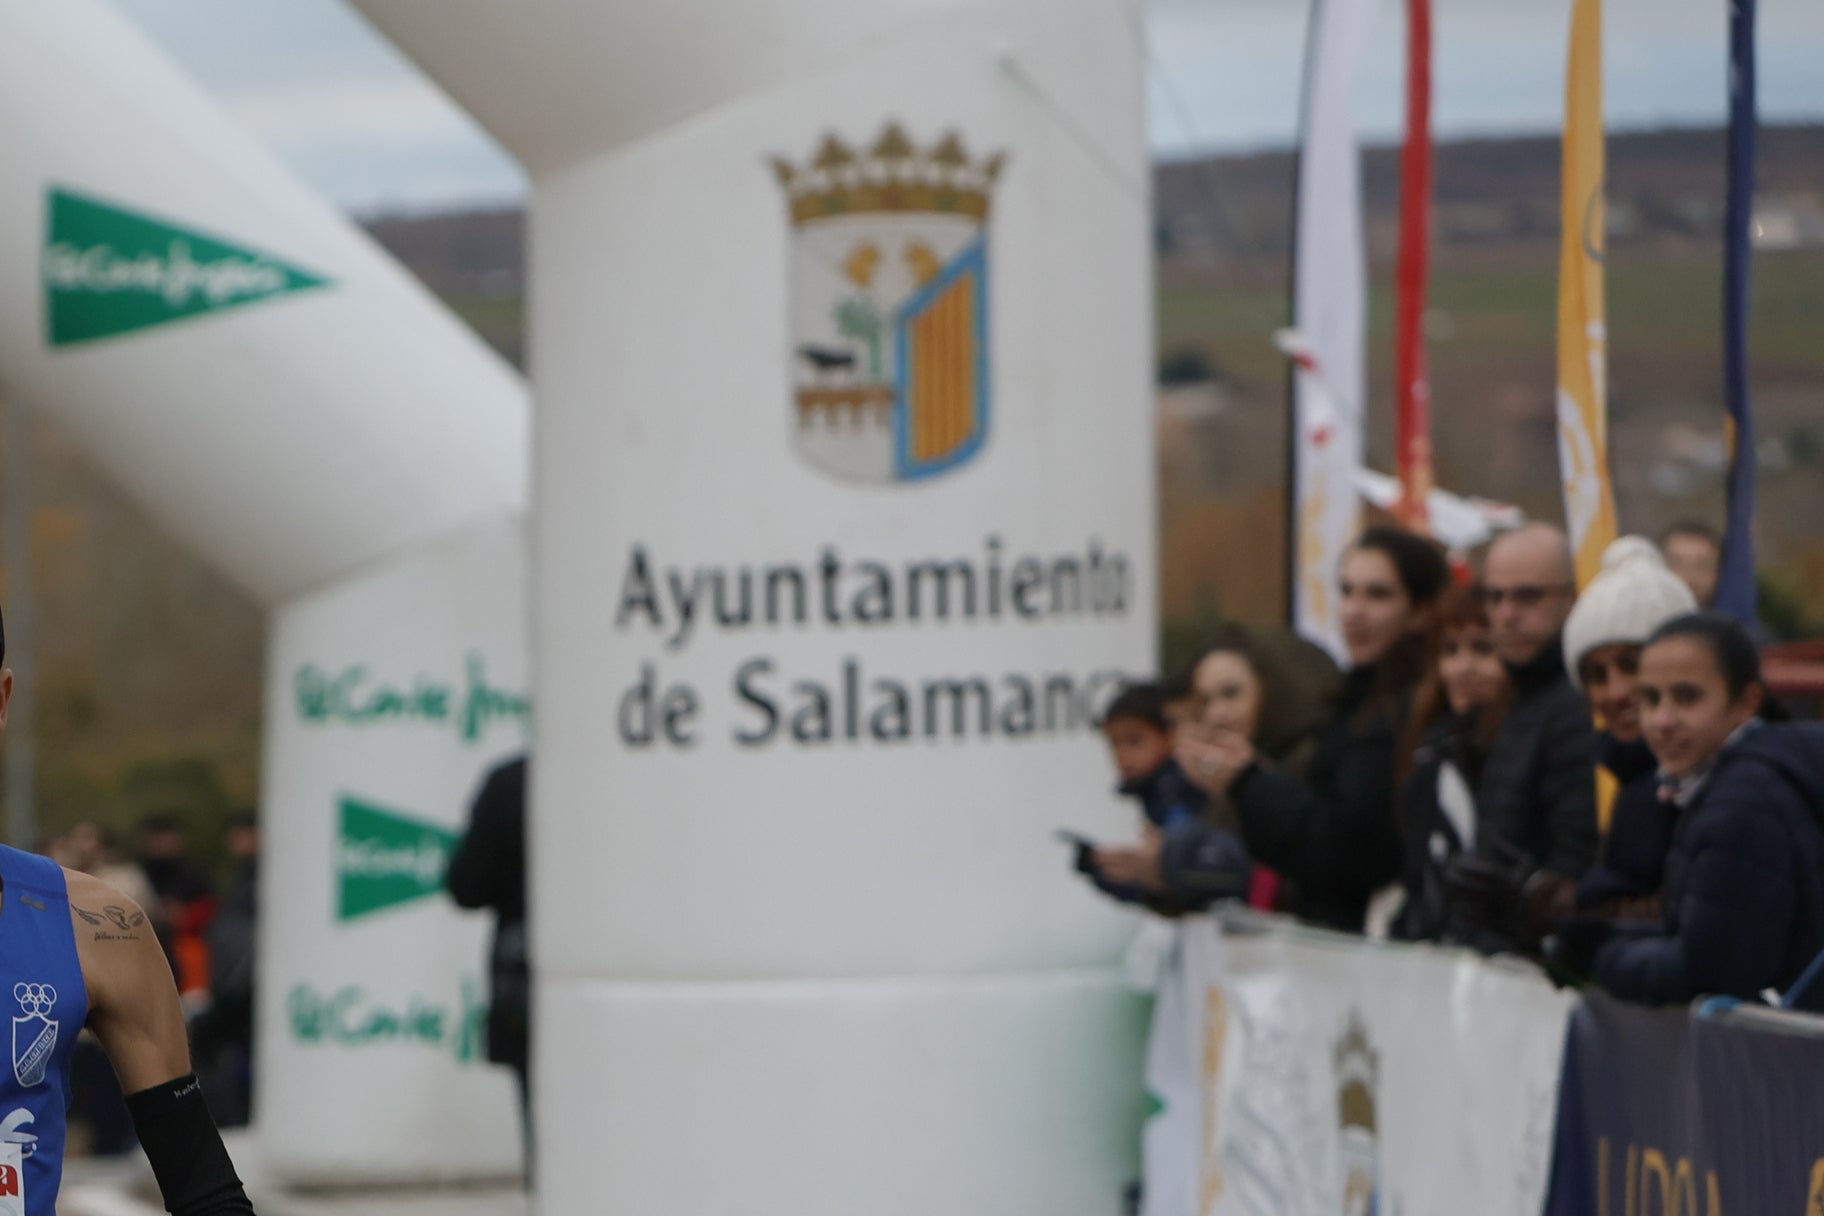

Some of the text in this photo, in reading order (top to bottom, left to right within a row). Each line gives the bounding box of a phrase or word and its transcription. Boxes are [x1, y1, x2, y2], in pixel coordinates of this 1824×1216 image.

[614, 534, 1131, 650] Ayuntamiento
[617, 662, 699, 747] de
[733, 657, 1124, 745] Salamanc
